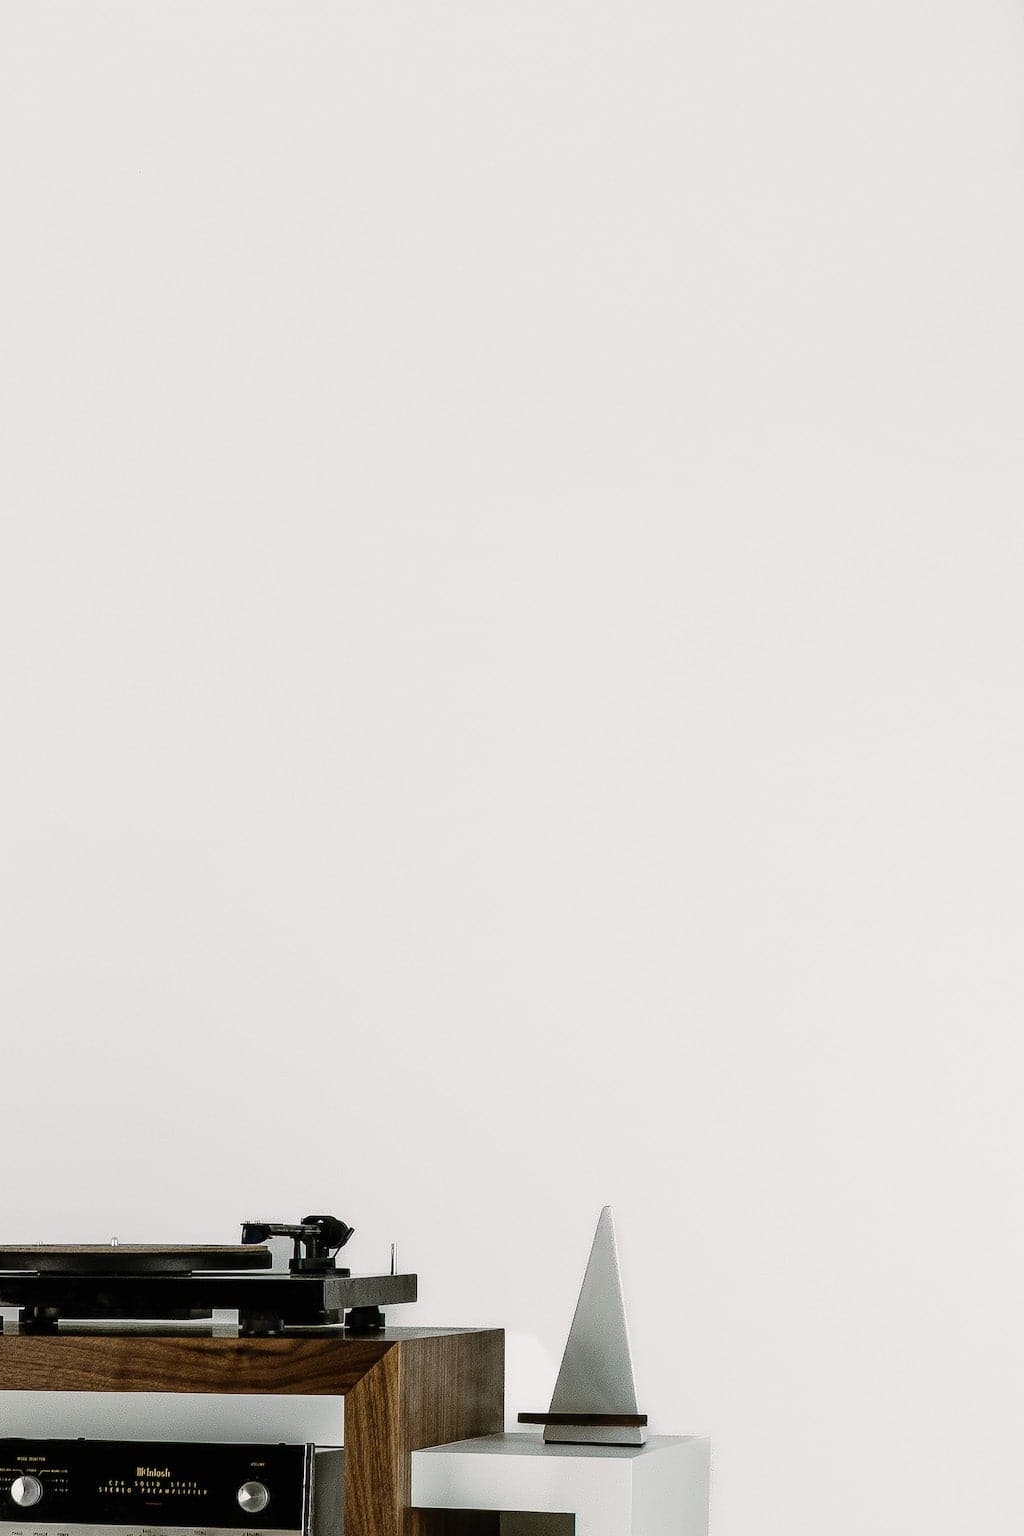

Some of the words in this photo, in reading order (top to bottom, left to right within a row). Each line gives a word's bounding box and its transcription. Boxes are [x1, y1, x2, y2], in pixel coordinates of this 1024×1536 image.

[136, 1466, 171, 1478] McIntosh
[134, 1480, 161, 1488] SOLID
[170, 1481, 197, 1489] STATE
[98, 1486, 132, 1494] STEREO
[141, 1487, 208, 1496] PREAMPLIFIER
